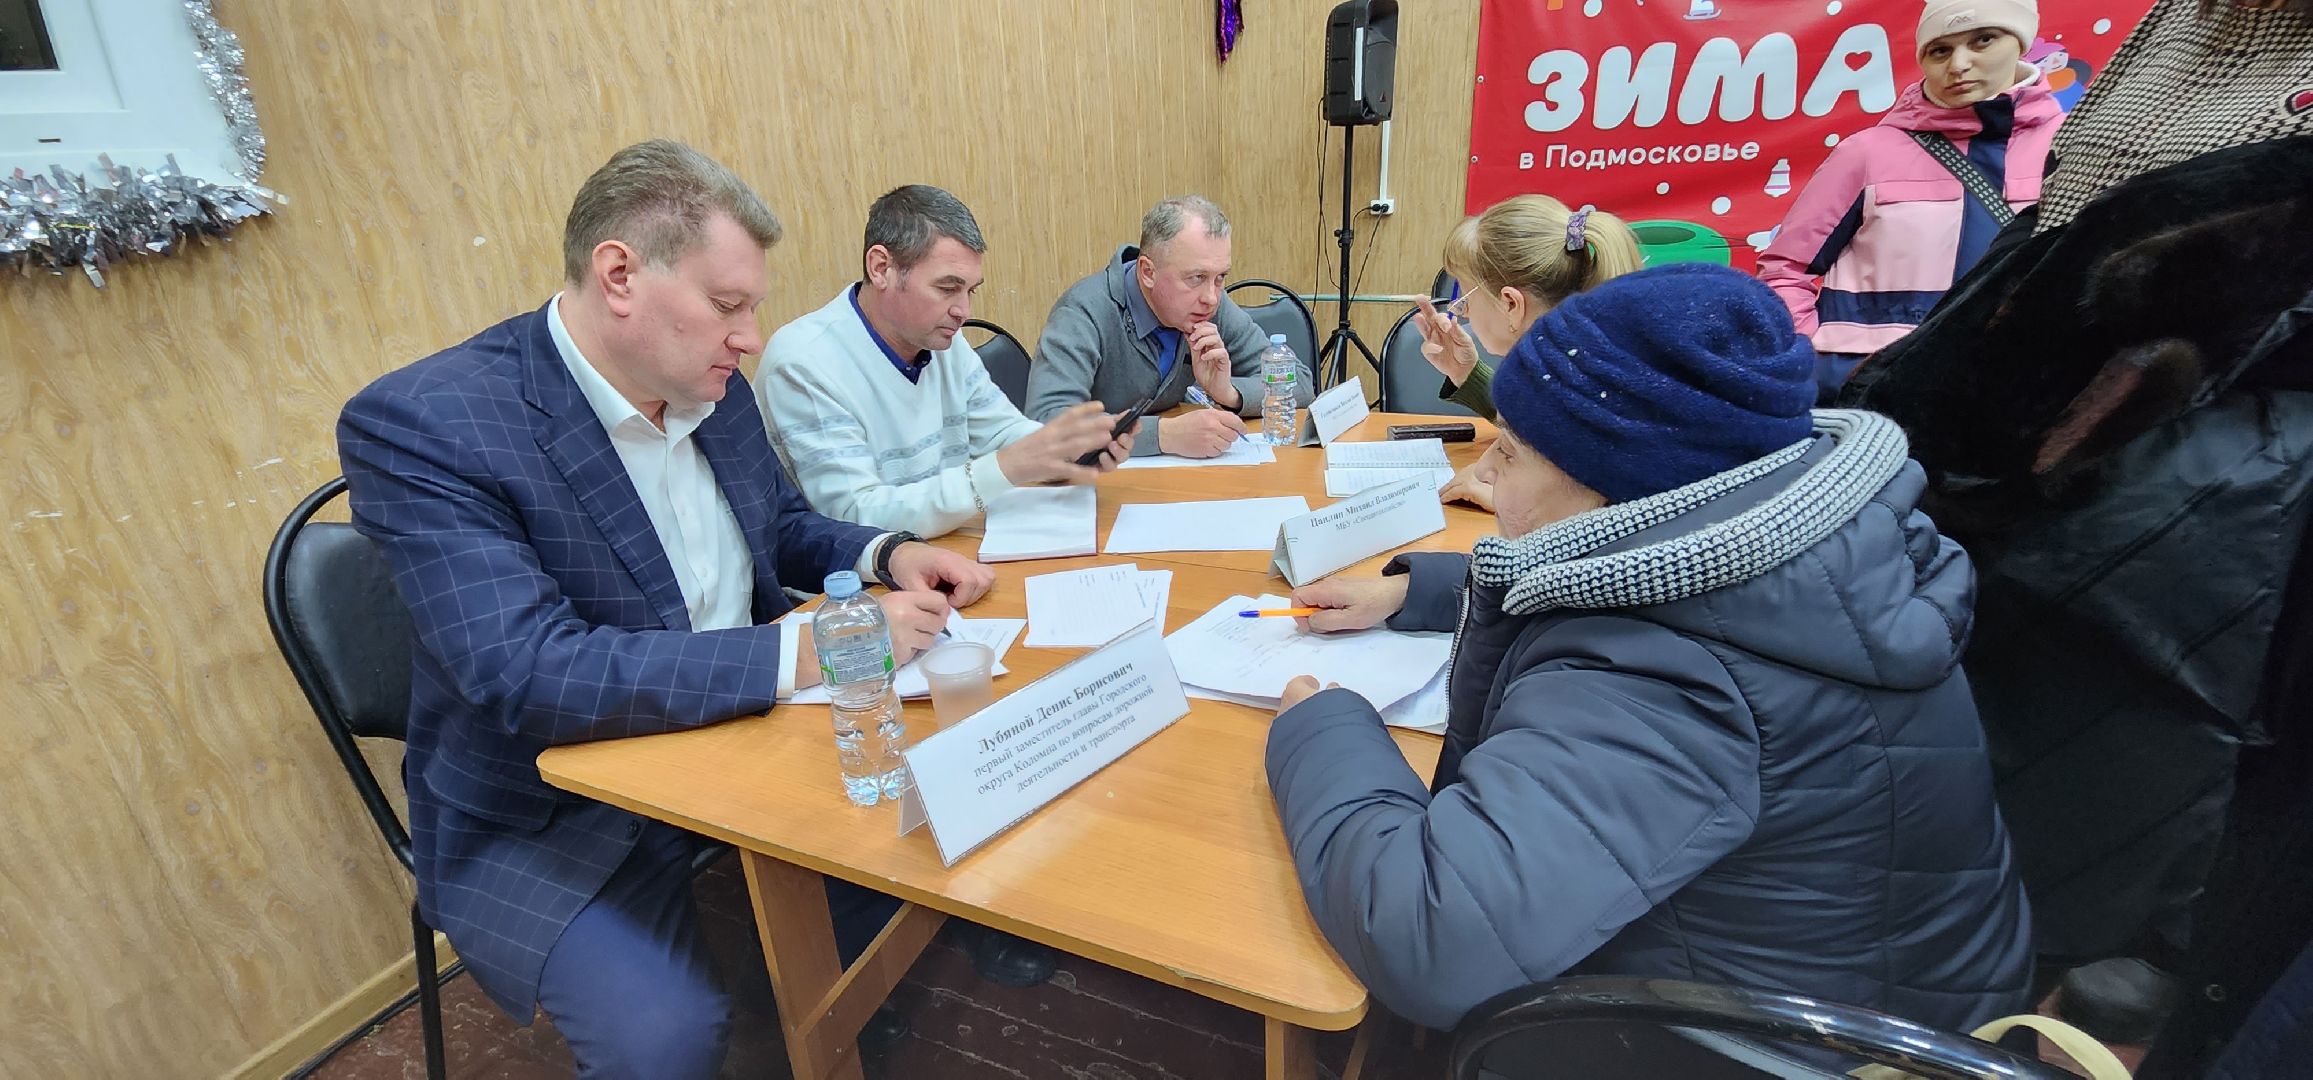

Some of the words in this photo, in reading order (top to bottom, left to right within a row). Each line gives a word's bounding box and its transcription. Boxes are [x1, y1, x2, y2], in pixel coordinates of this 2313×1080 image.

[1524, 23, 1896, 132] ЗИМА
[1519, 152, 1535, 169] в
[1545, 141, 1760, 170] Подмосковье
[974, 748, 1013, 777] первый
[1015, 718, 1072, 753] заместитель
[1073, 702, 1099, 720] главы
[1099, 674, 1147, 705] Городского
[978, 714, 1035, 754] Лубяной
[1036, 696, 1072, 724] Денис
[1073, 662, 1133, 700] Борисович
[978, 769, 1013, 795] округа
[1014, 743, 1058, 773] Коломна
[1058, 736, 1071, 747] по
[1072, 711, 1113, 740] вопросам
[1114, 685, 1154, 715] дорожной
[1017, 749, 1080, 793] деятельности
[1080, 744, 1088, 753] и
[1088, 715, 1136, 748] транспорта
